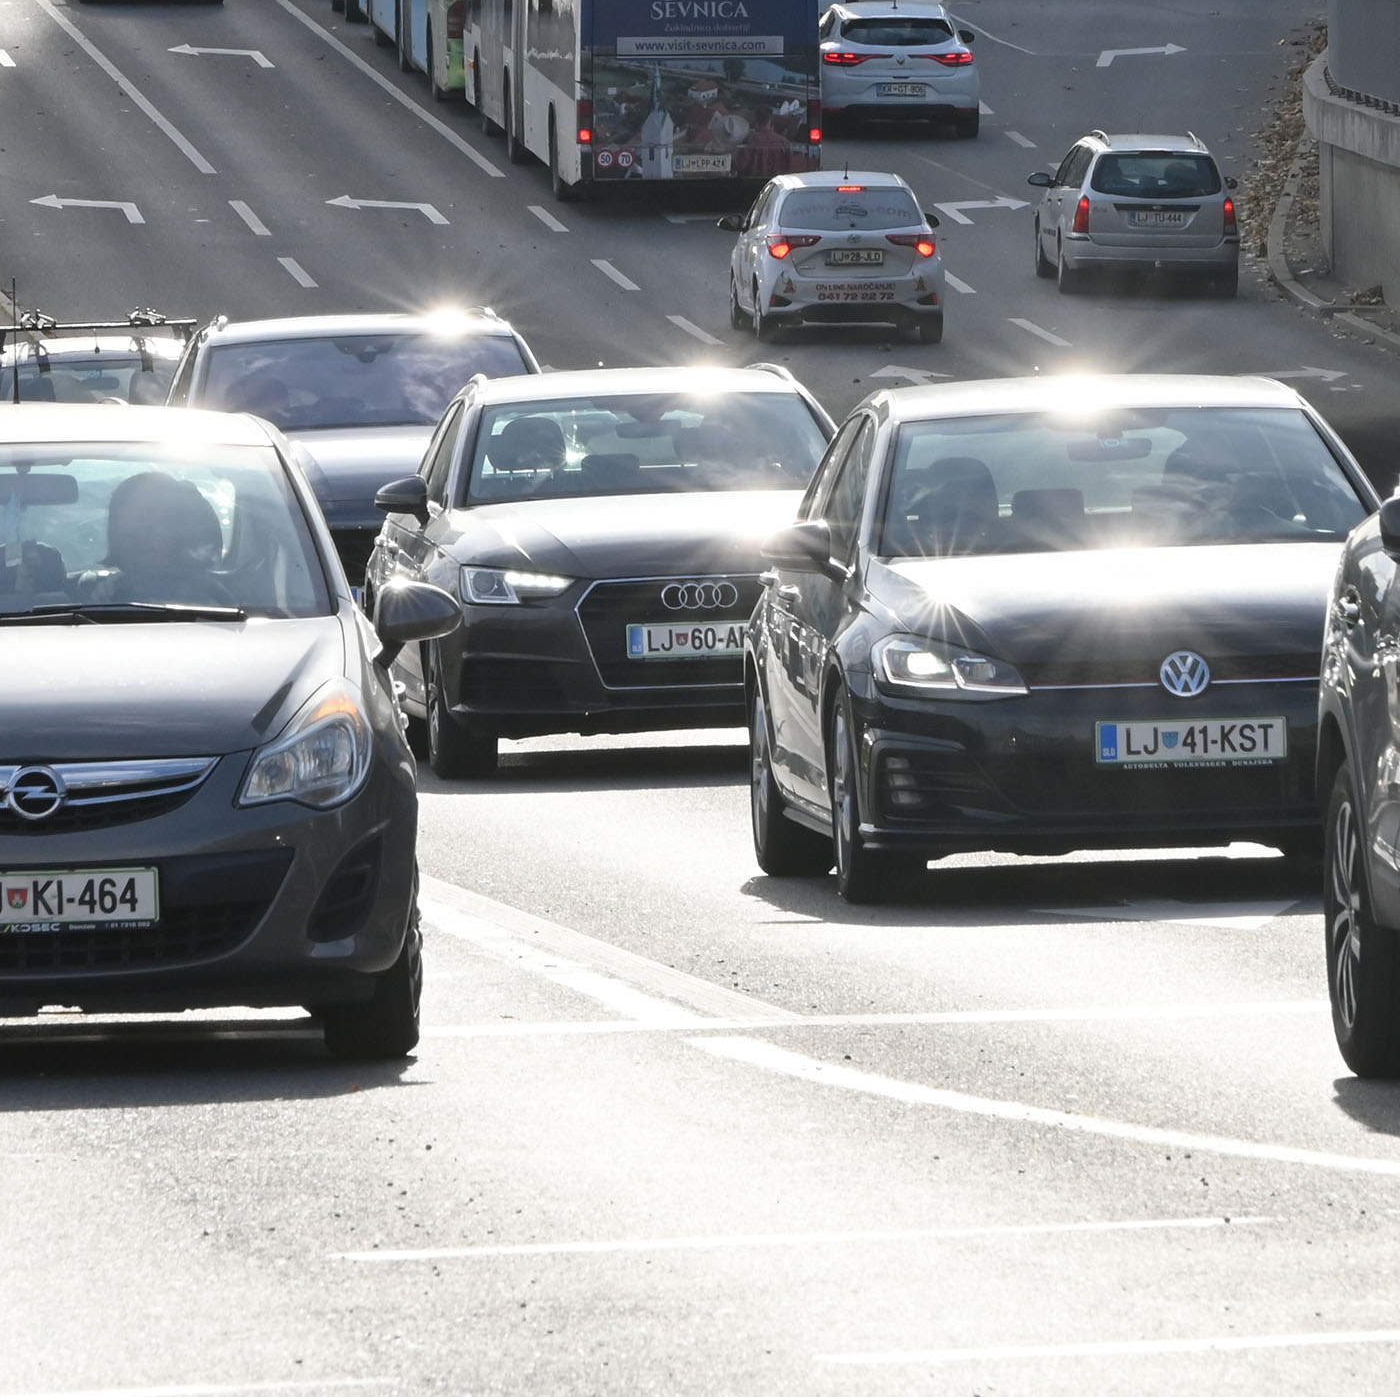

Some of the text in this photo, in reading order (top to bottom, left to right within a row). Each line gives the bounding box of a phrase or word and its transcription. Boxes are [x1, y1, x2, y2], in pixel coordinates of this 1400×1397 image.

[651, 0, 749, 21] SEVNICA
[634, 38, 766, 52] www.visit-sevnica.com
[600, 154, 611, 164] 50
[620, 154, 631, 164] 70
[843, 292, 858, 301] 72
[879, 292, 895, 301] 72
[1181, 723, 1274, 754] 41-KST
[31, 876, 138, 917] KI-464
